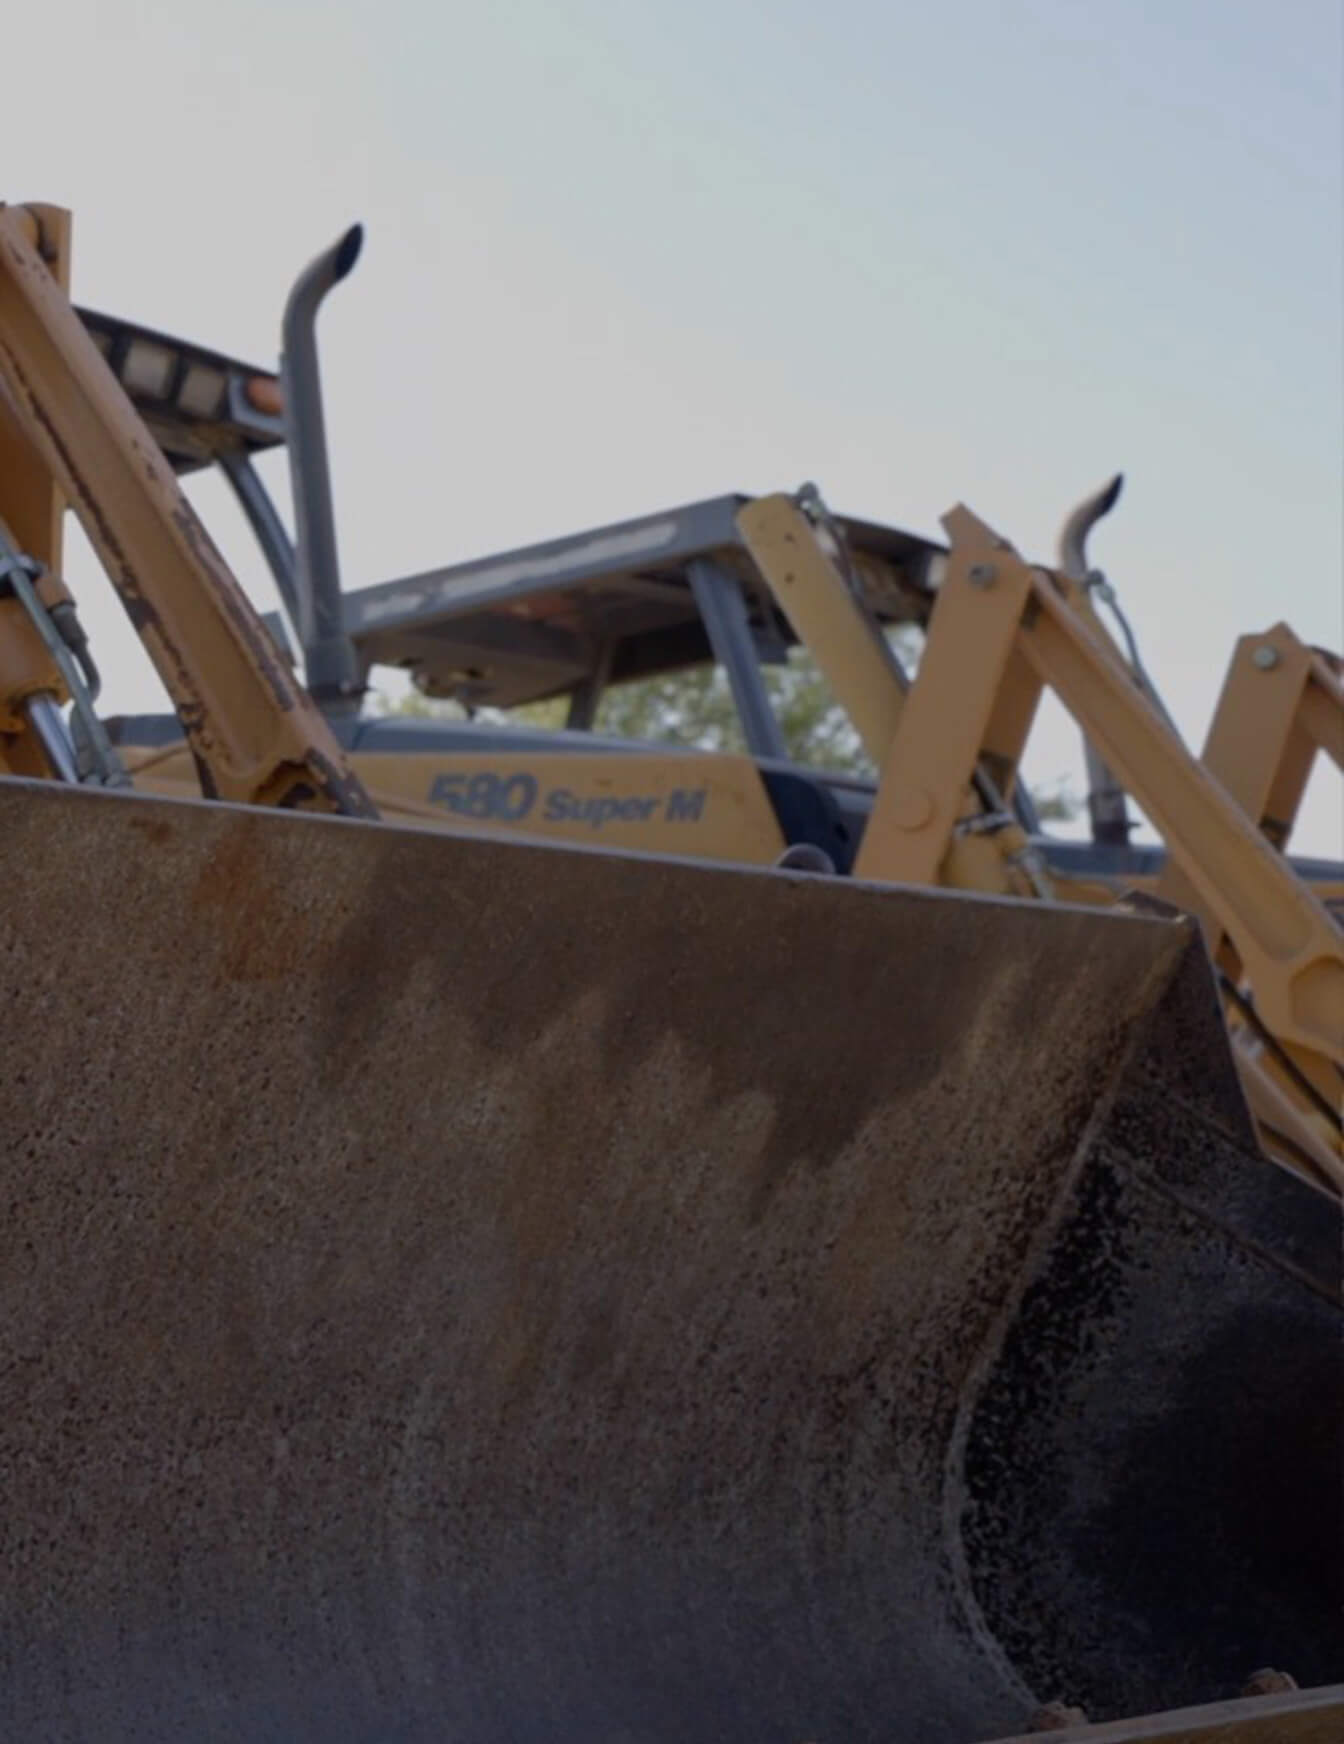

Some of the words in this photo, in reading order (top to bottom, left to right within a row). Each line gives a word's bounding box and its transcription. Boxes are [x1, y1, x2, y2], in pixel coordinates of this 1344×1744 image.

[428, 772, 539, 823] 580
[543, 786, 658, 830] Super
[665, 788, 708, 823] M
